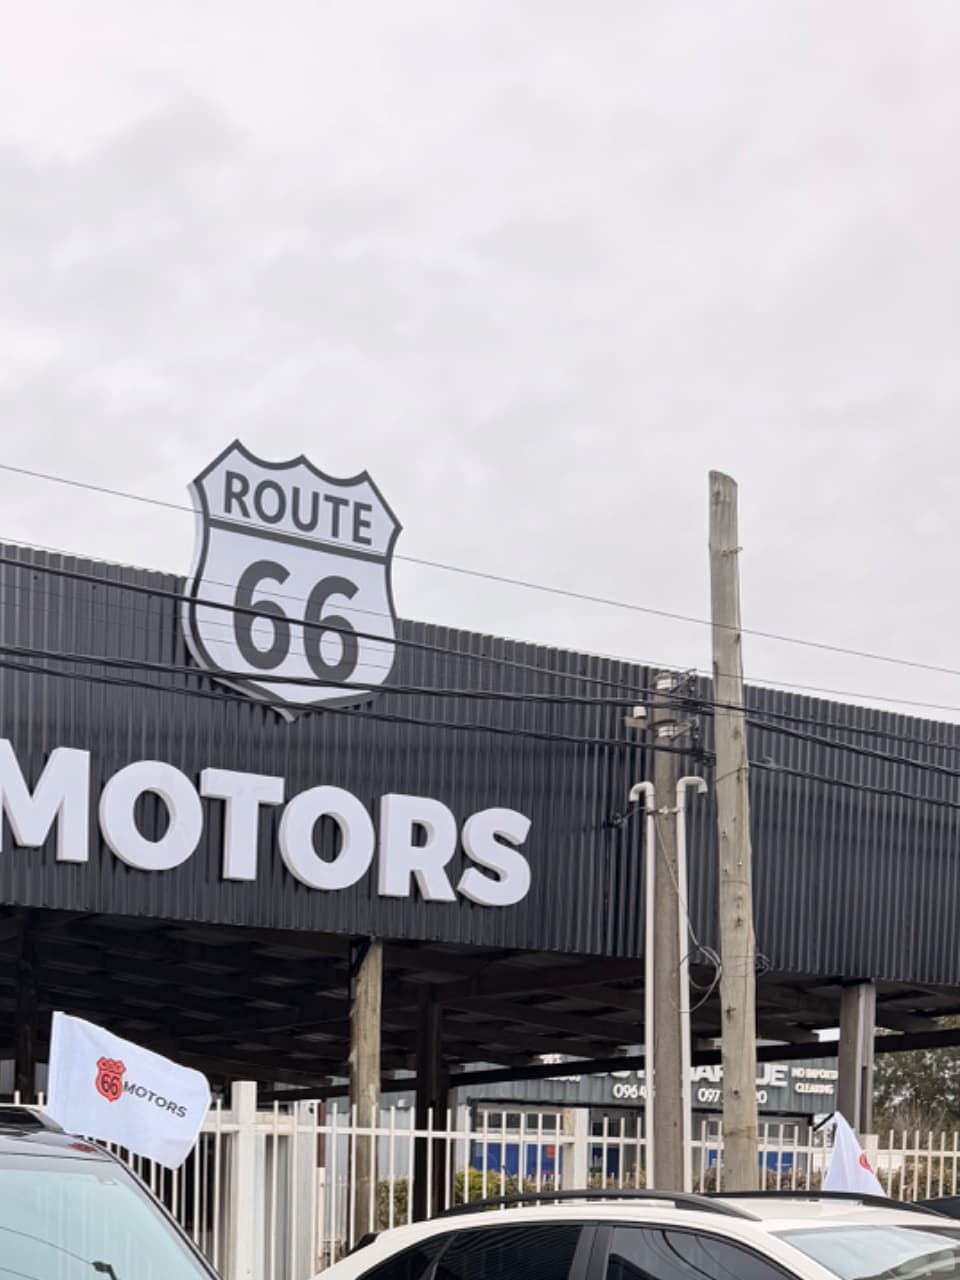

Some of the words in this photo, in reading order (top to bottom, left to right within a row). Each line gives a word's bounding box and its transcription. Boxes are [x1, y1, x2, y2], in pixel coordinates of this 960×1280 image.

[223, 470, 374, 547] ROUTE
[233, 559, 360, 684] 66
[100, 1073, 120, 1096] 66
[123, 1080, 188, 1118] MOTORS
